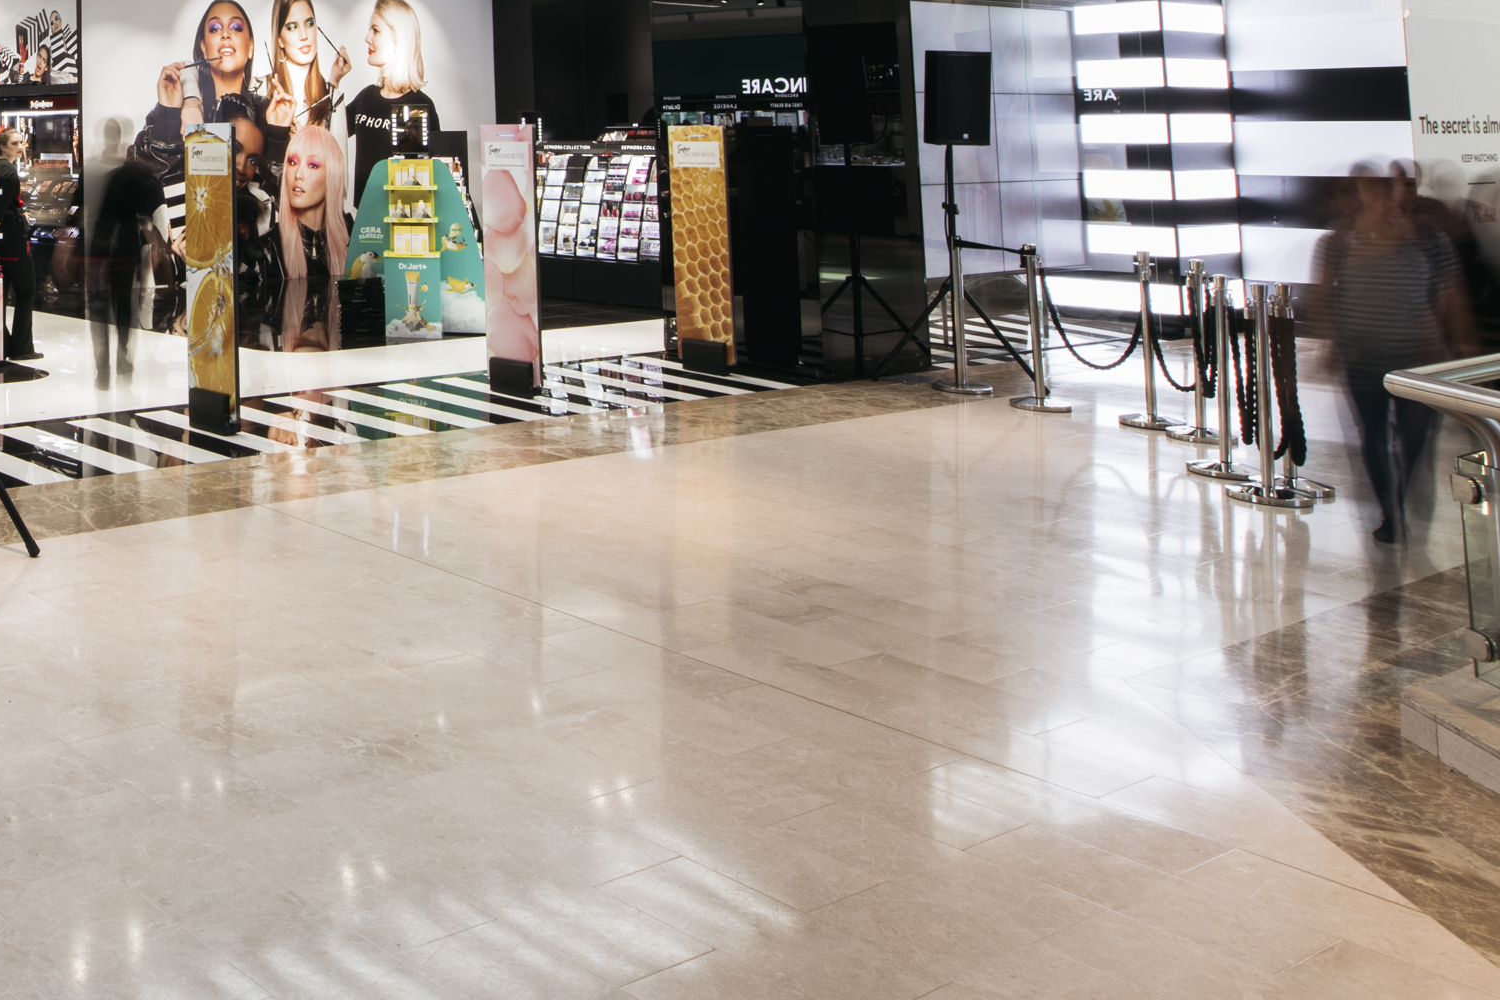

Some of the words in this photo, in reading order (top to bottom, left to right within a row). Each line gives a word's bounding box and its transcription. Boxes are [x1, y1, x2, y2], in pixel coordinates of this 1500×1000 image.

[1419, 114, 1439, 135] The
[1441, 117, 1472, 135] secret
[1472, 114, 1481, 134] is
[1482, 114, 1500, 134] alm
[191, 146, 204, 159] Super
[488, 144, 502, 156] Super
[677, 144, 691, 154] Super
[1461, 153, 1473, 163] KEEP
[1473, 153, 1498, 163] WATCHING
[360, 226, 382, 234] CERA
[358, 233, 384, 241] FANTASY
[398, 262, 428, 270] Dr.Jart+
